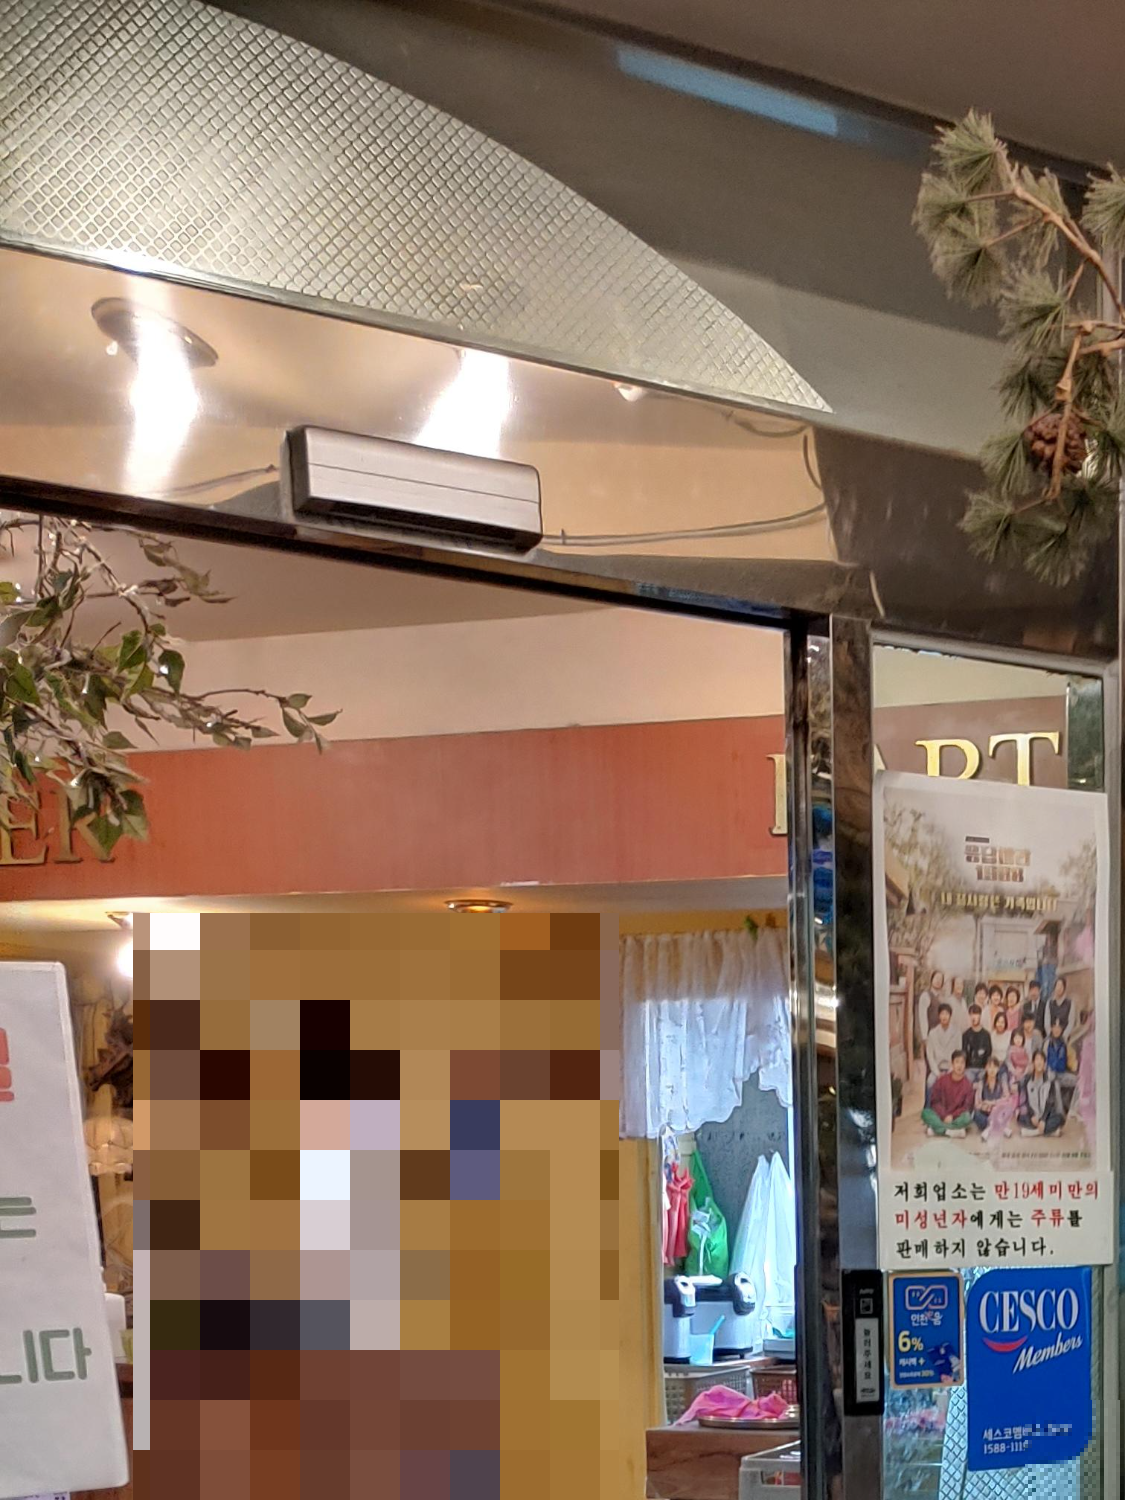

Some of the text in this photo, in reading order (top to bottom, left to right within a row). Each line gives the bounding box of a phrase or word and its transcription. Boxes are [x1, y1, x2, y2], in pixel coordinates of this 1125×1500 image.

[895, 1209, 1083, 1229] 미성년자에게는 주류를
[896, 1237, 1054, 1259] 판매하지 않습니다.
[979, 1287, 1080, 1335] CESCO
[1012, 1331, 1083, 1375] Members
